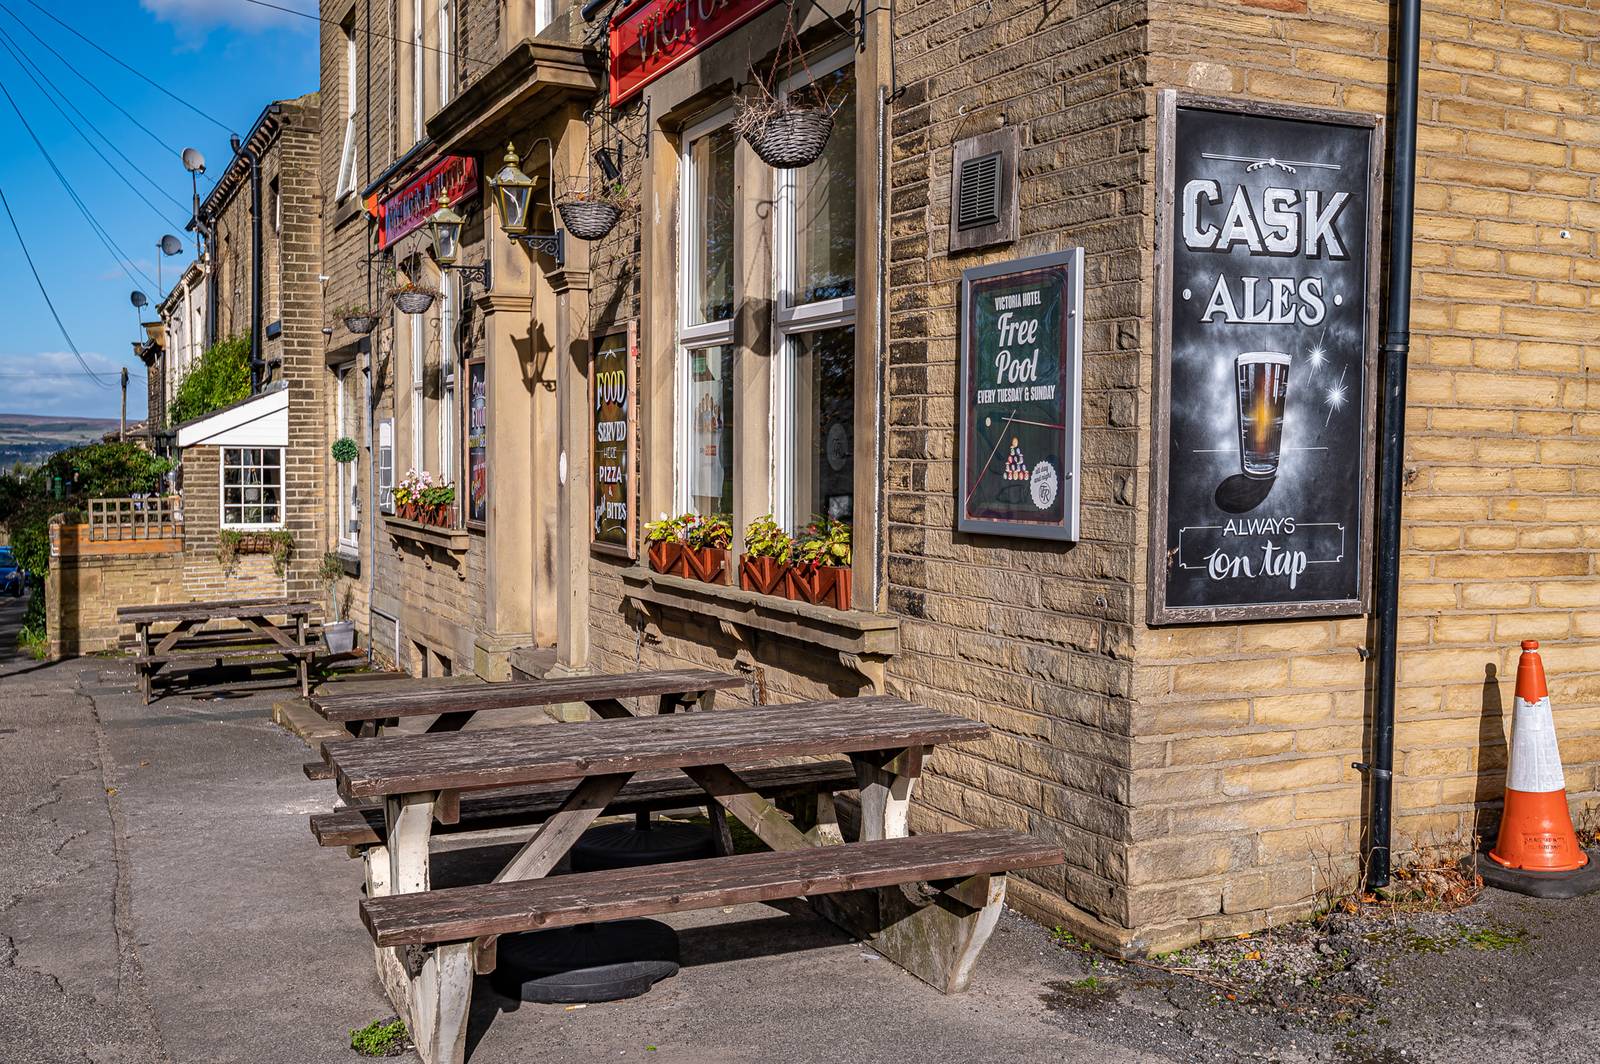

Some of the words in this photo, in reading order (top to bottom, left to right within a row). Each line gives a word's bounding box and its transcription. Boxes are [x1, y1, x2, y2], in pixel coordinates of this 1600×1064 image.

[638, 0, 729, 62] VICTO
[1182, 179, 1351, 258] CASK
[995, 294, 1021, 311] VICTORIA
[1022, 290, 1042, 307] HOTEL
[1200, 272, 1327, 326] ALES
[997, 312, 1038, 347] Free
[995, 348, 1039, 384] Pool
[596, 370, 626, 411] FOOD
[977, 389, 996, 404] EVERY
[997, 387, 1024, 403] TUESDAY
[1024, 386, 1030, 401] &
[1030, 385, 1056, 400] SUNDAY
[597, 420, 627, 442] SERVED
[603, 446, 617, 458] HERE
[599, 465, 623, 484] PIZZA
[606, 502, 628, 520] BITES
[1223, 517, 1296, 536] ALWAYS
[1259, 539, 1307, 590] tap
